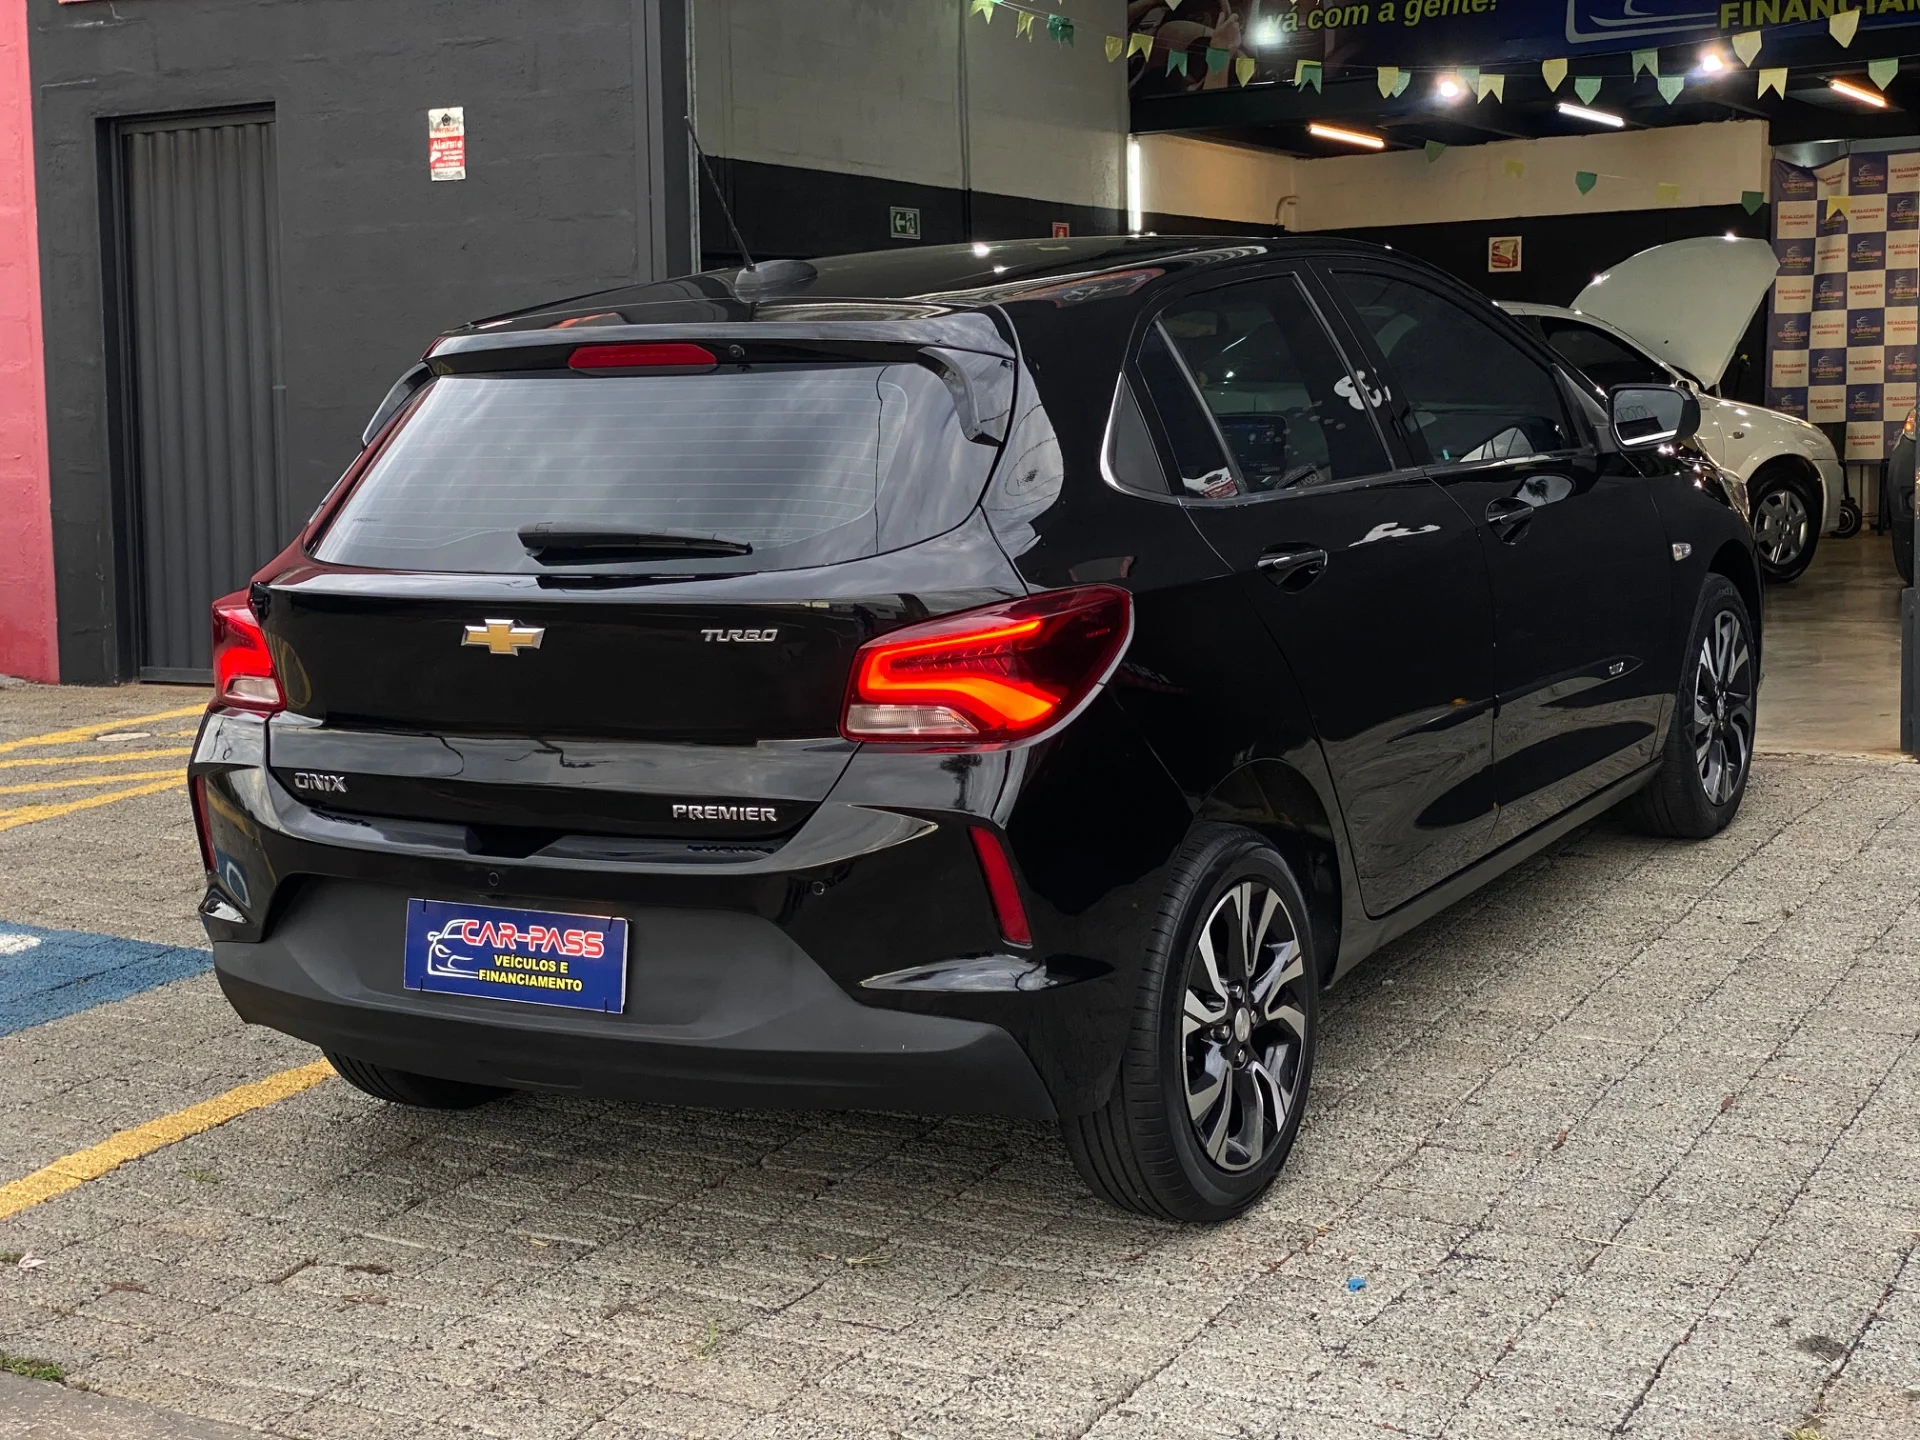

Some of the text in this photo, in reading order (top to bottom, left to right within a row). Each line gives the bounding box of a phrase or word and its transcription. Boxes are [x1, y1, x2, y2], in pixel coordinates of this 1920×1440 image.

[1306, 4, 1370, 31] com
[1377, 2, 1395, 23] a
[432, 139, 463, 150] Alarme
[700, 629, 778, 642] TURBO
[294, 772, 348, 793] ONIX
[672, 804, 777, 822] PREMIER
[461, 920, 604, 958] CAR-PASS
[494, 953, 568, 974] VEÍCULOS E
[478, 969, 583, 992] FINANCIAMENTO
